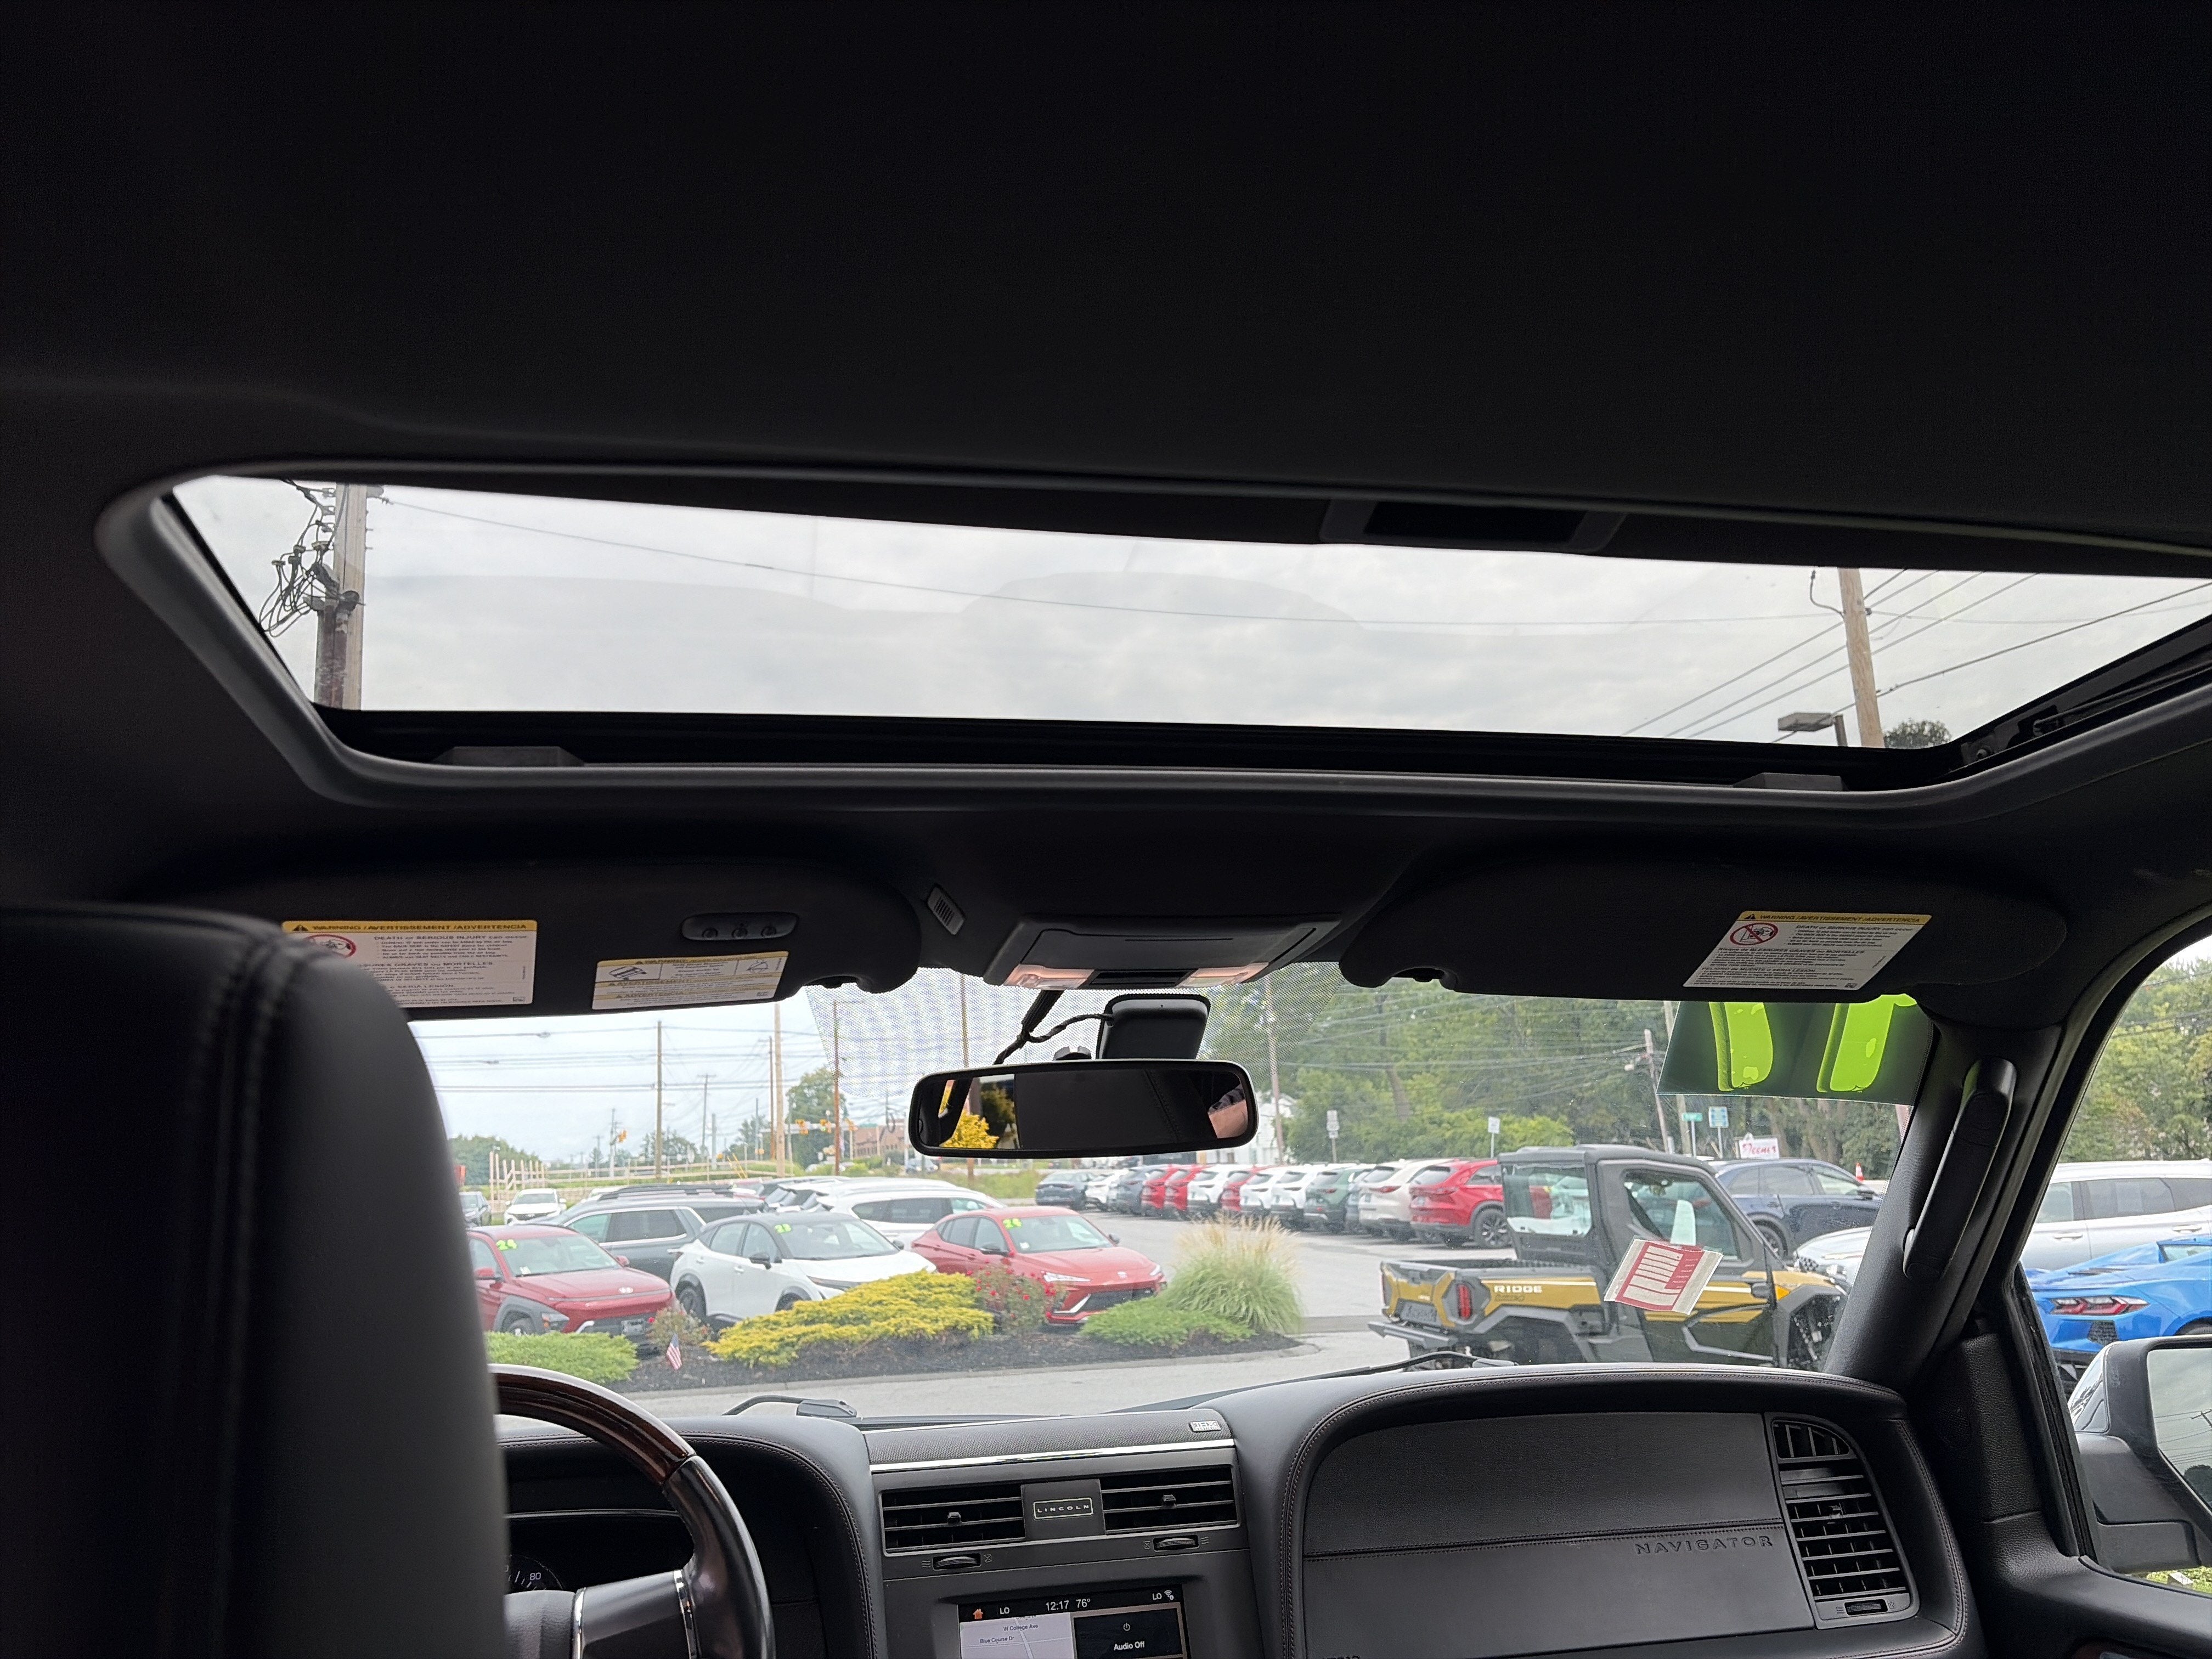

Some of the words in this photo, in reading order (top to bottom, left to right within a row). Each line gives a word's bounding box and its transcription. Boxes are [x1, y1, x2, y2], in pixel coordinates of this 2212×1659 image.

[1037, 1504, 1090, 1513] LINCOLN
[1635, 1536, 1773, 1554] NAVIGATOR
[529, 1572, 541, 1581] 80
[1000, 1606, 1009, 1615] LO
[1045, 1600, 1069, 1611] 12:17
[1075, 1598, 1091, 1609] 76°
[1152, 1592, 1162, 1601] LO
[1114, 1643, 1133, 1651] Audio
